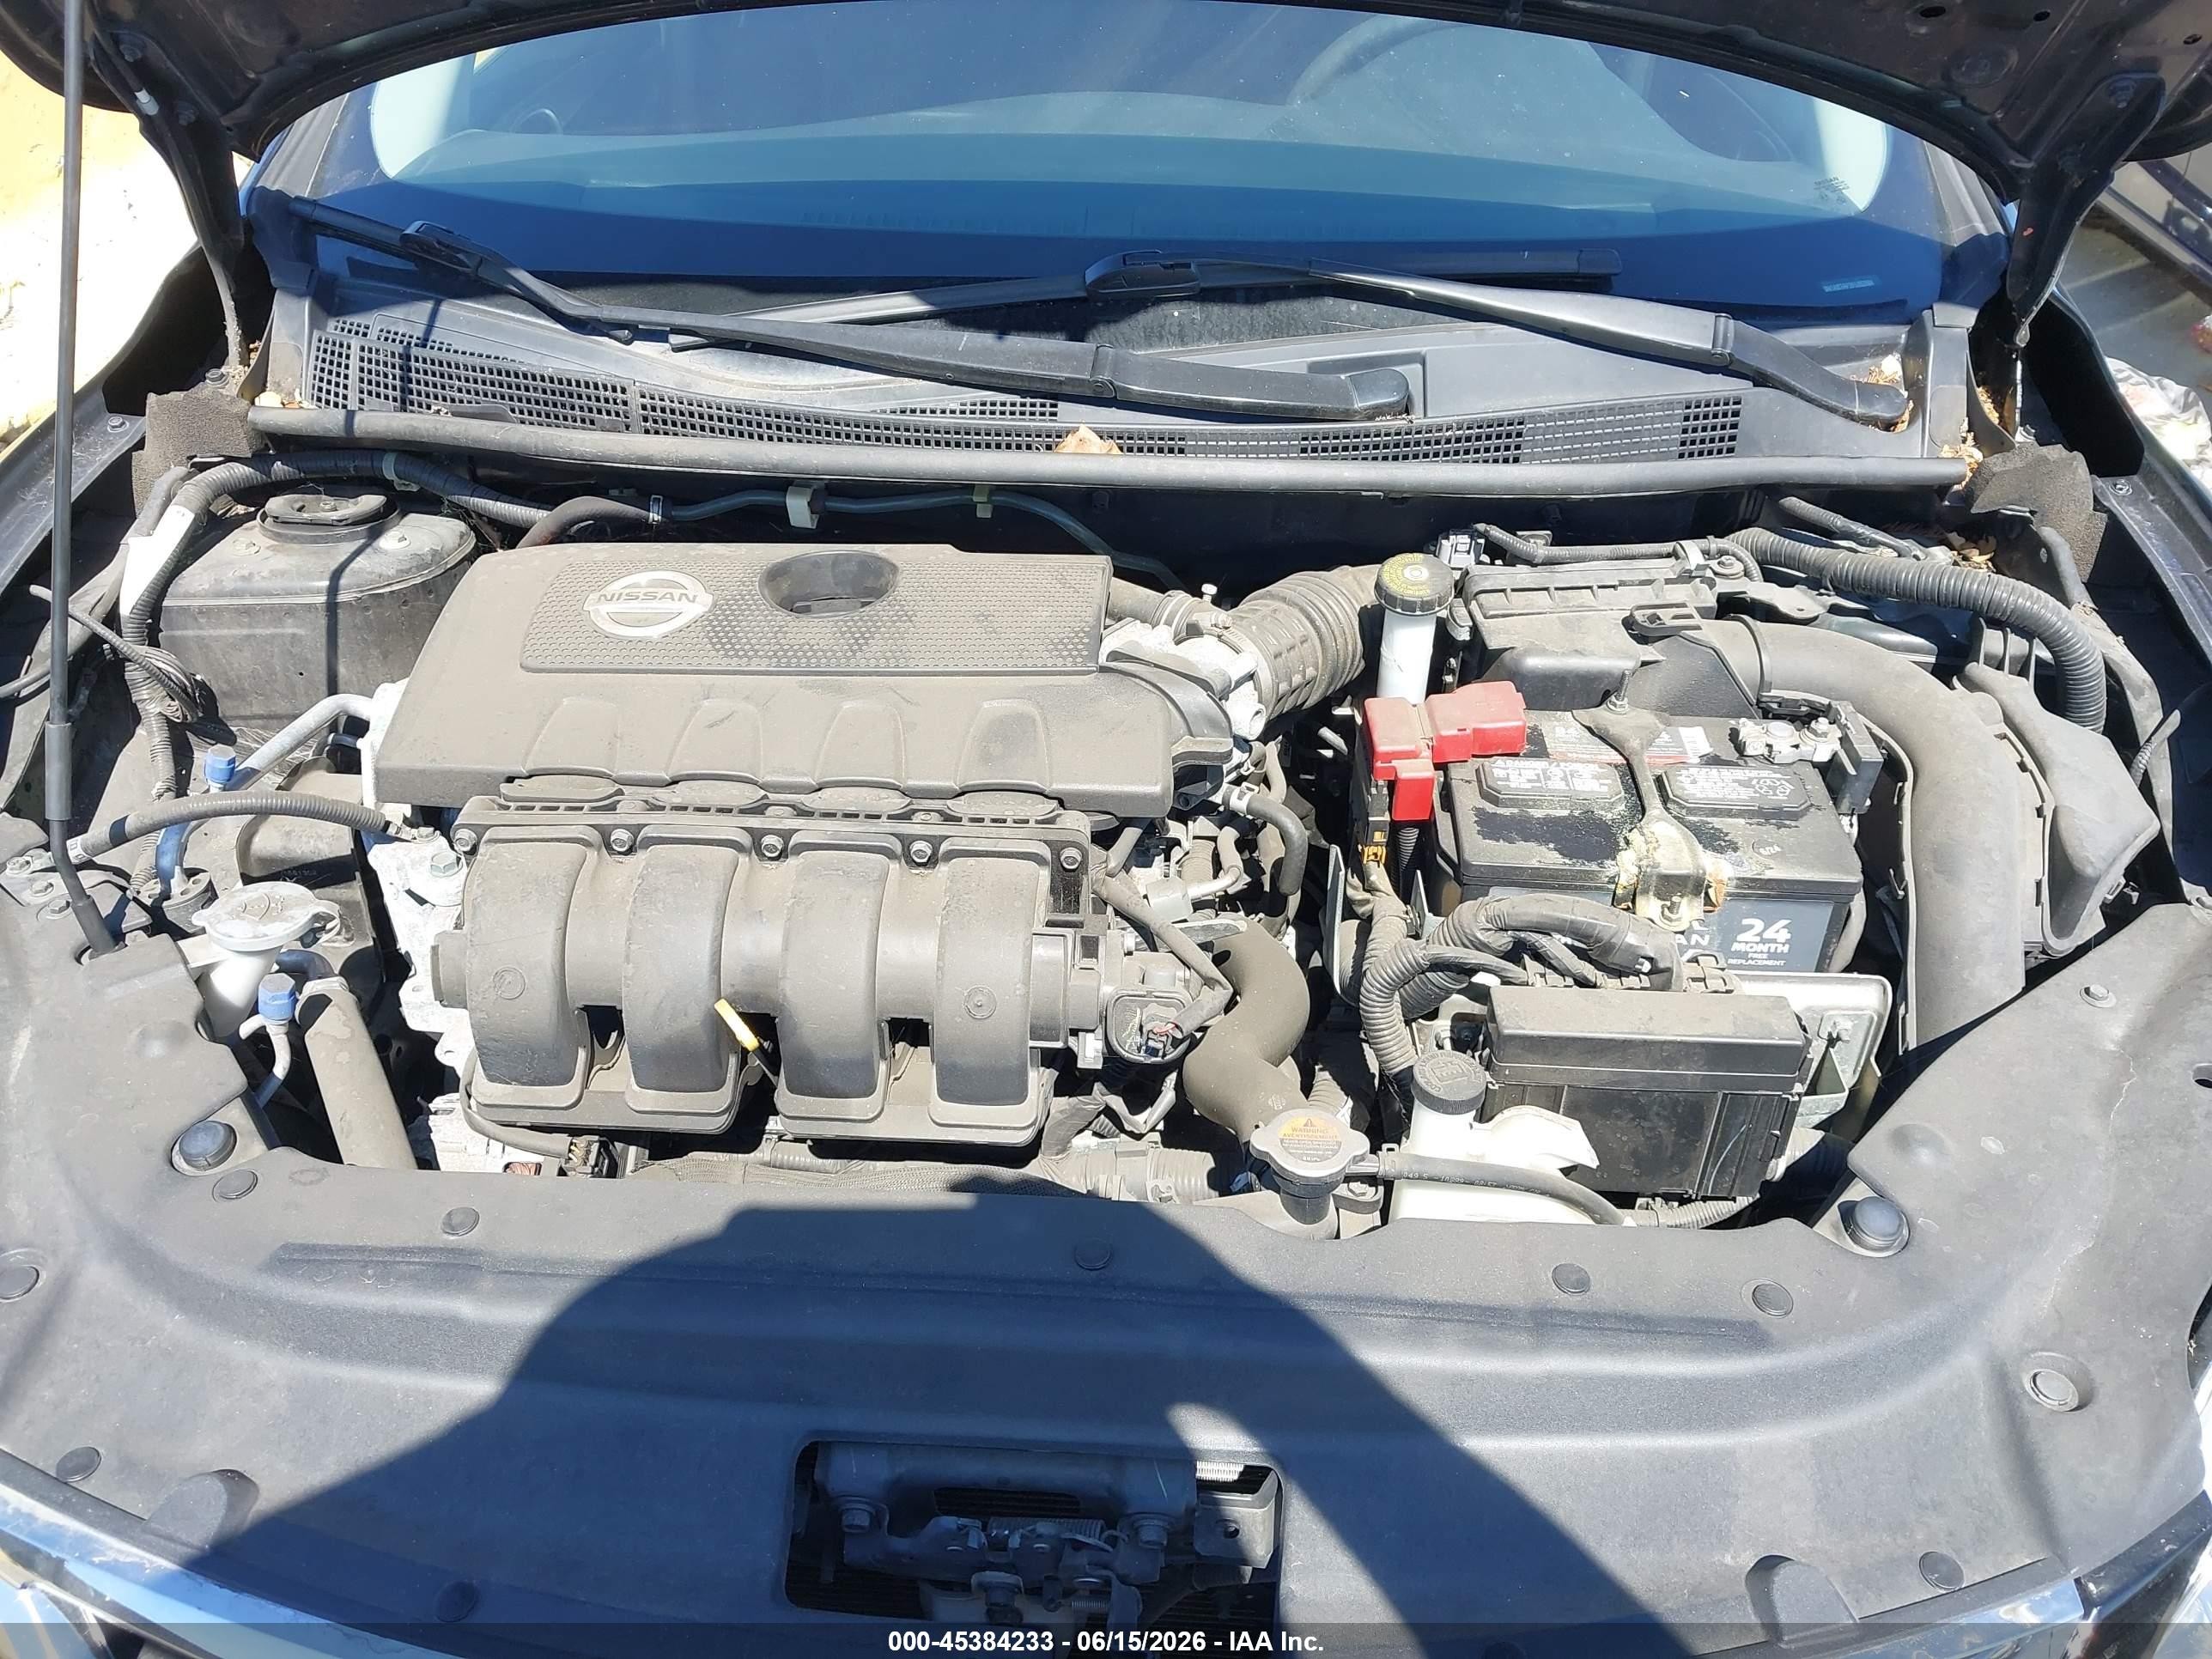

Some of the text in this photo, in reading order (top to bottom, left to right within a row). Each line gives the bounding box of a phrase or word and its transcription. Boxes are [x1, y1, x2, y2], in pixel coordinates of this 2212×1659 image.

[597, 591, 698, 604] NISSAN
[1736, 918, 1792, 943] 24
[1730, 942, 1790, 954] MONTH
[1728, 958, 1787, 967] REPLACEMENT
